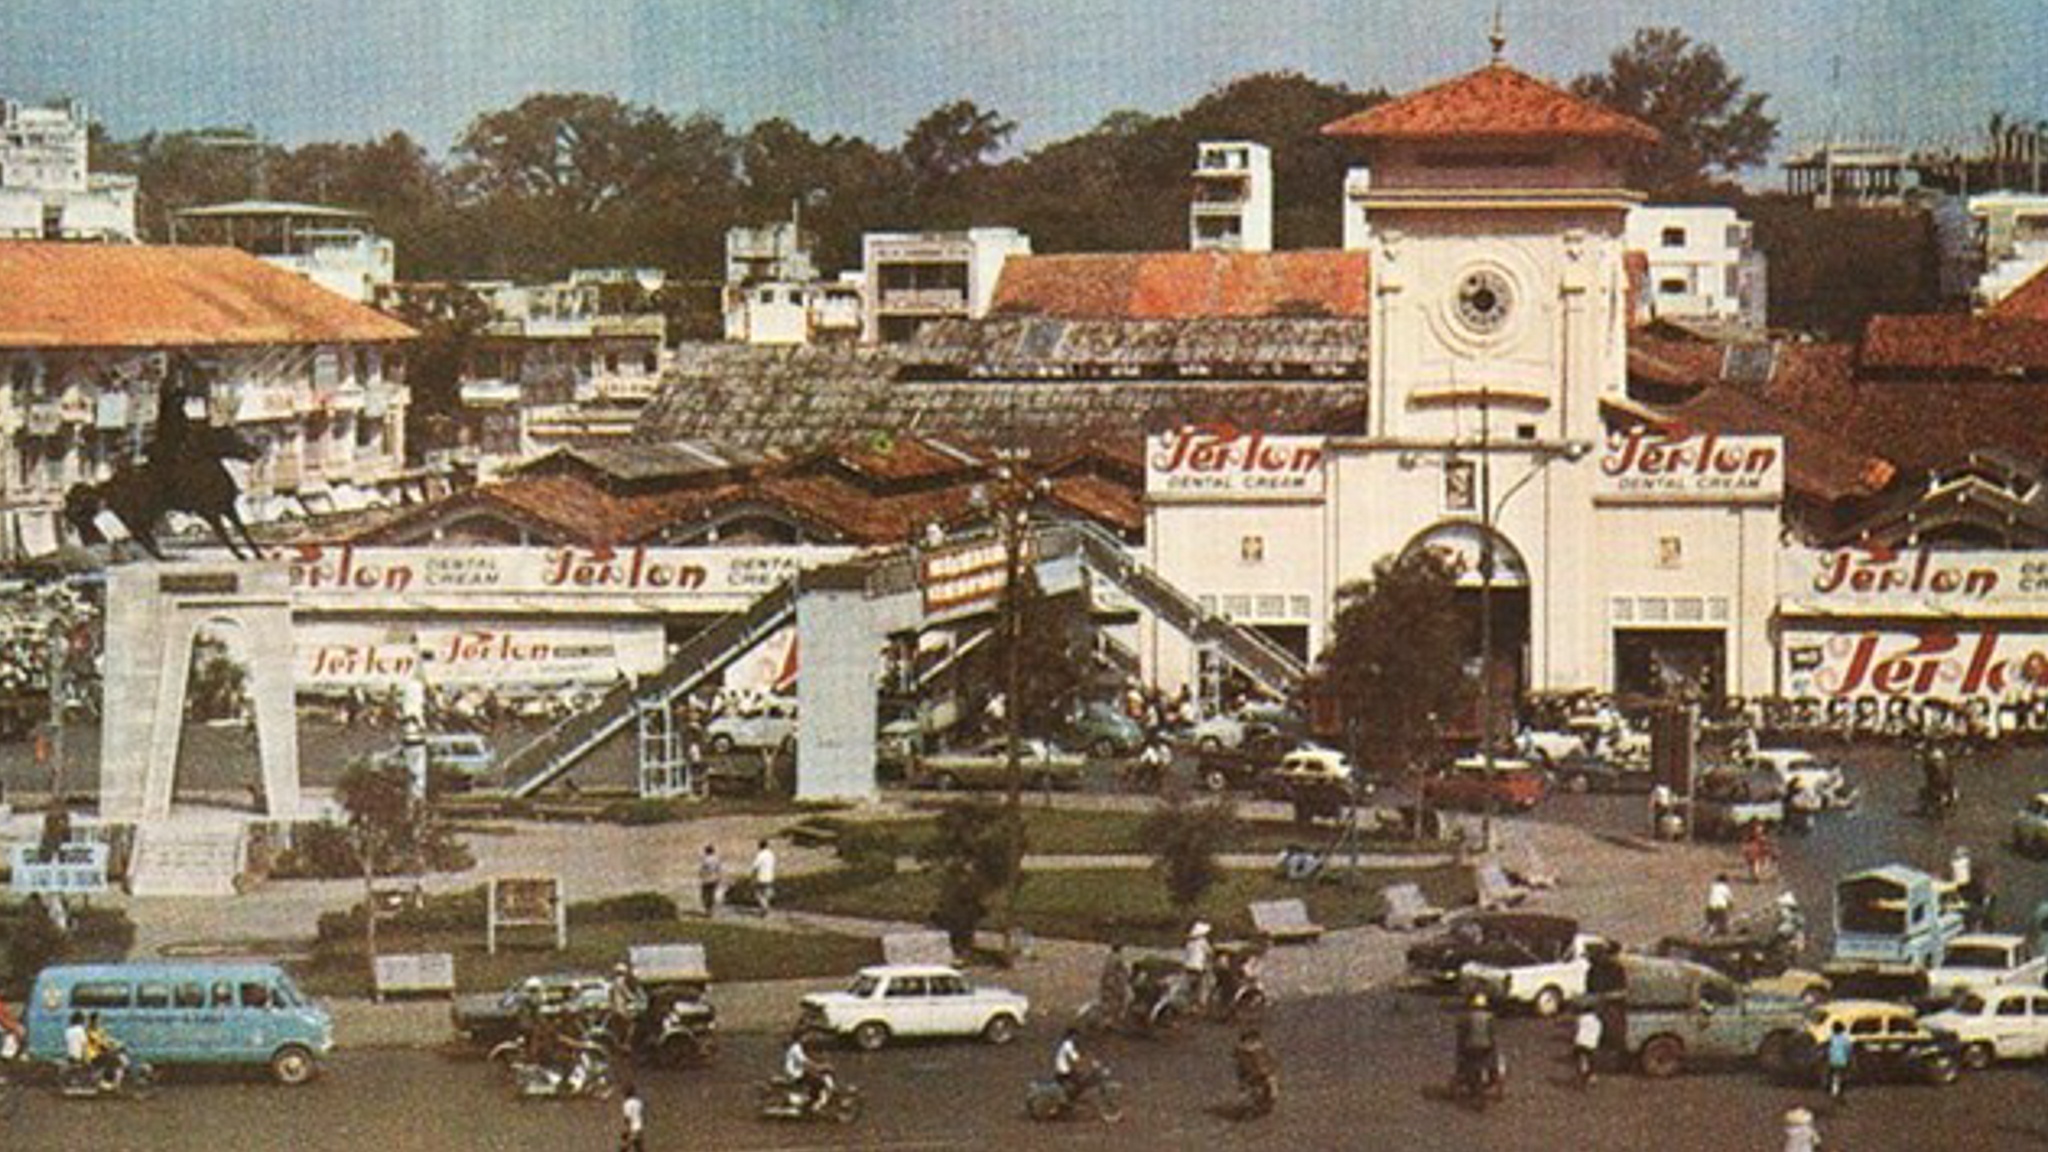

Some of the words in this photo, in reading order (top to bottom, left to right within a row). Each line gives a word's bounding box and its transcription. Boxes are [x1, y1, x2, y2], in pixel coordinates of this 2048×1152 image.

[1167, 476, 1232, 488] DENTAL
[1244, 476, 1306, 488] CREAM
[1618, 475, 1685, 489] DENTAL
[1696, 476, 1761, 489] CREAM
[427, 556, 496, 570] DENTAL
[426, 571, 500, 585] CREAM
